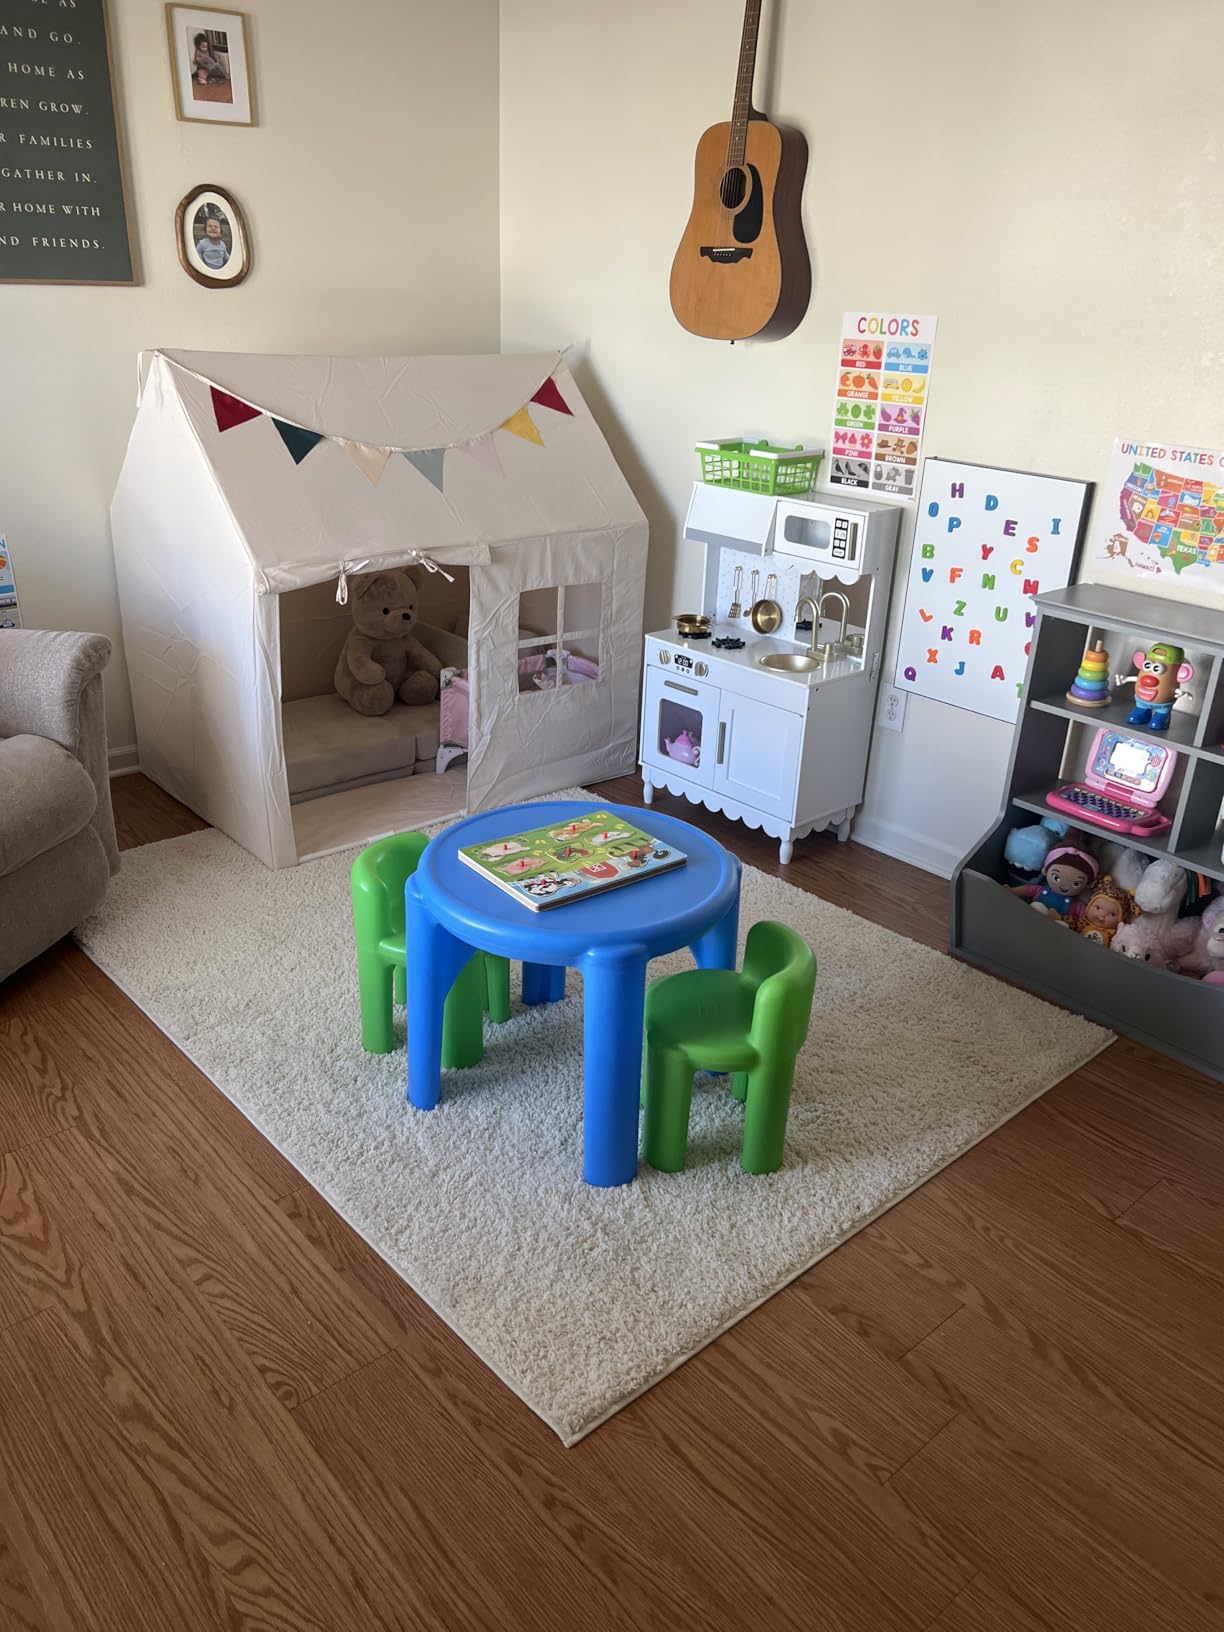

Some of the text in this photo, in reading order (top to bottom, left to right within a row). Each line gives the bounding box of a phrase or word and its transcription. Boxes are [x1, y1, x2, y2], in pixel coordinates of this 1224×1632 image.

[0, 25, 81, 45] AND GO.
[8, 62, 84, 80] HOME AS
[39, 101, 89, 115] GROW.
[19, 134, 92, 149] FAMILIES
[1, 167, 97, 183] GATHER IN.
[12, 202, 56, 214] HOME
[61, 205, 100, 217] WITH
[32, 236, 105, 249] FRIENDS.
[857, 316, 920, 337] COLORS
[899, 363, 913, 372] BLUE
[847, 390, 869, 399] ORANGE
[847, 420, 864, 428] GREEN
[888, 425, 909, 434] PURPLE
[844, 449, 859, 457] PINK
[885, 455, 906, 464] BROWN
[1121, 443, 1166, 459] UNITED
[1170, 449, 1215, 466] STATES
[841, 478, 858, 486] BLACK
[951, 483, 965, 498] H
[985, 495, 999, 511] D
[947, 517, 961, 532] P
[1003, 519, 1018, 536] E
[1051, 518, 1061, 535] I
[922, 544, 935, 559] B
[981, 544, 994, 560] Y
[1026, 536, 1040, 553] S
[1177, 544, 1197, 555] TEXAS
[921, 567, 934, 582] V
[949, 567, 963, 583] F
[1010, 559, 1024, 575] C
[982, 573, 996, 590] N
[1023, 579, 1039, 595] M
[918, 608, 933, 622] L
[953, 600, 967, 616] Z
[995, 606, 1008, 622] U
[941, 625, 954, 641] K
[968, 629, 981, 645] R
[927, 648, 938, 664] X
[904, 666, 917, 681] Q
[954, 661, 966, 675] J
[991, 665, 1005, 681] A
